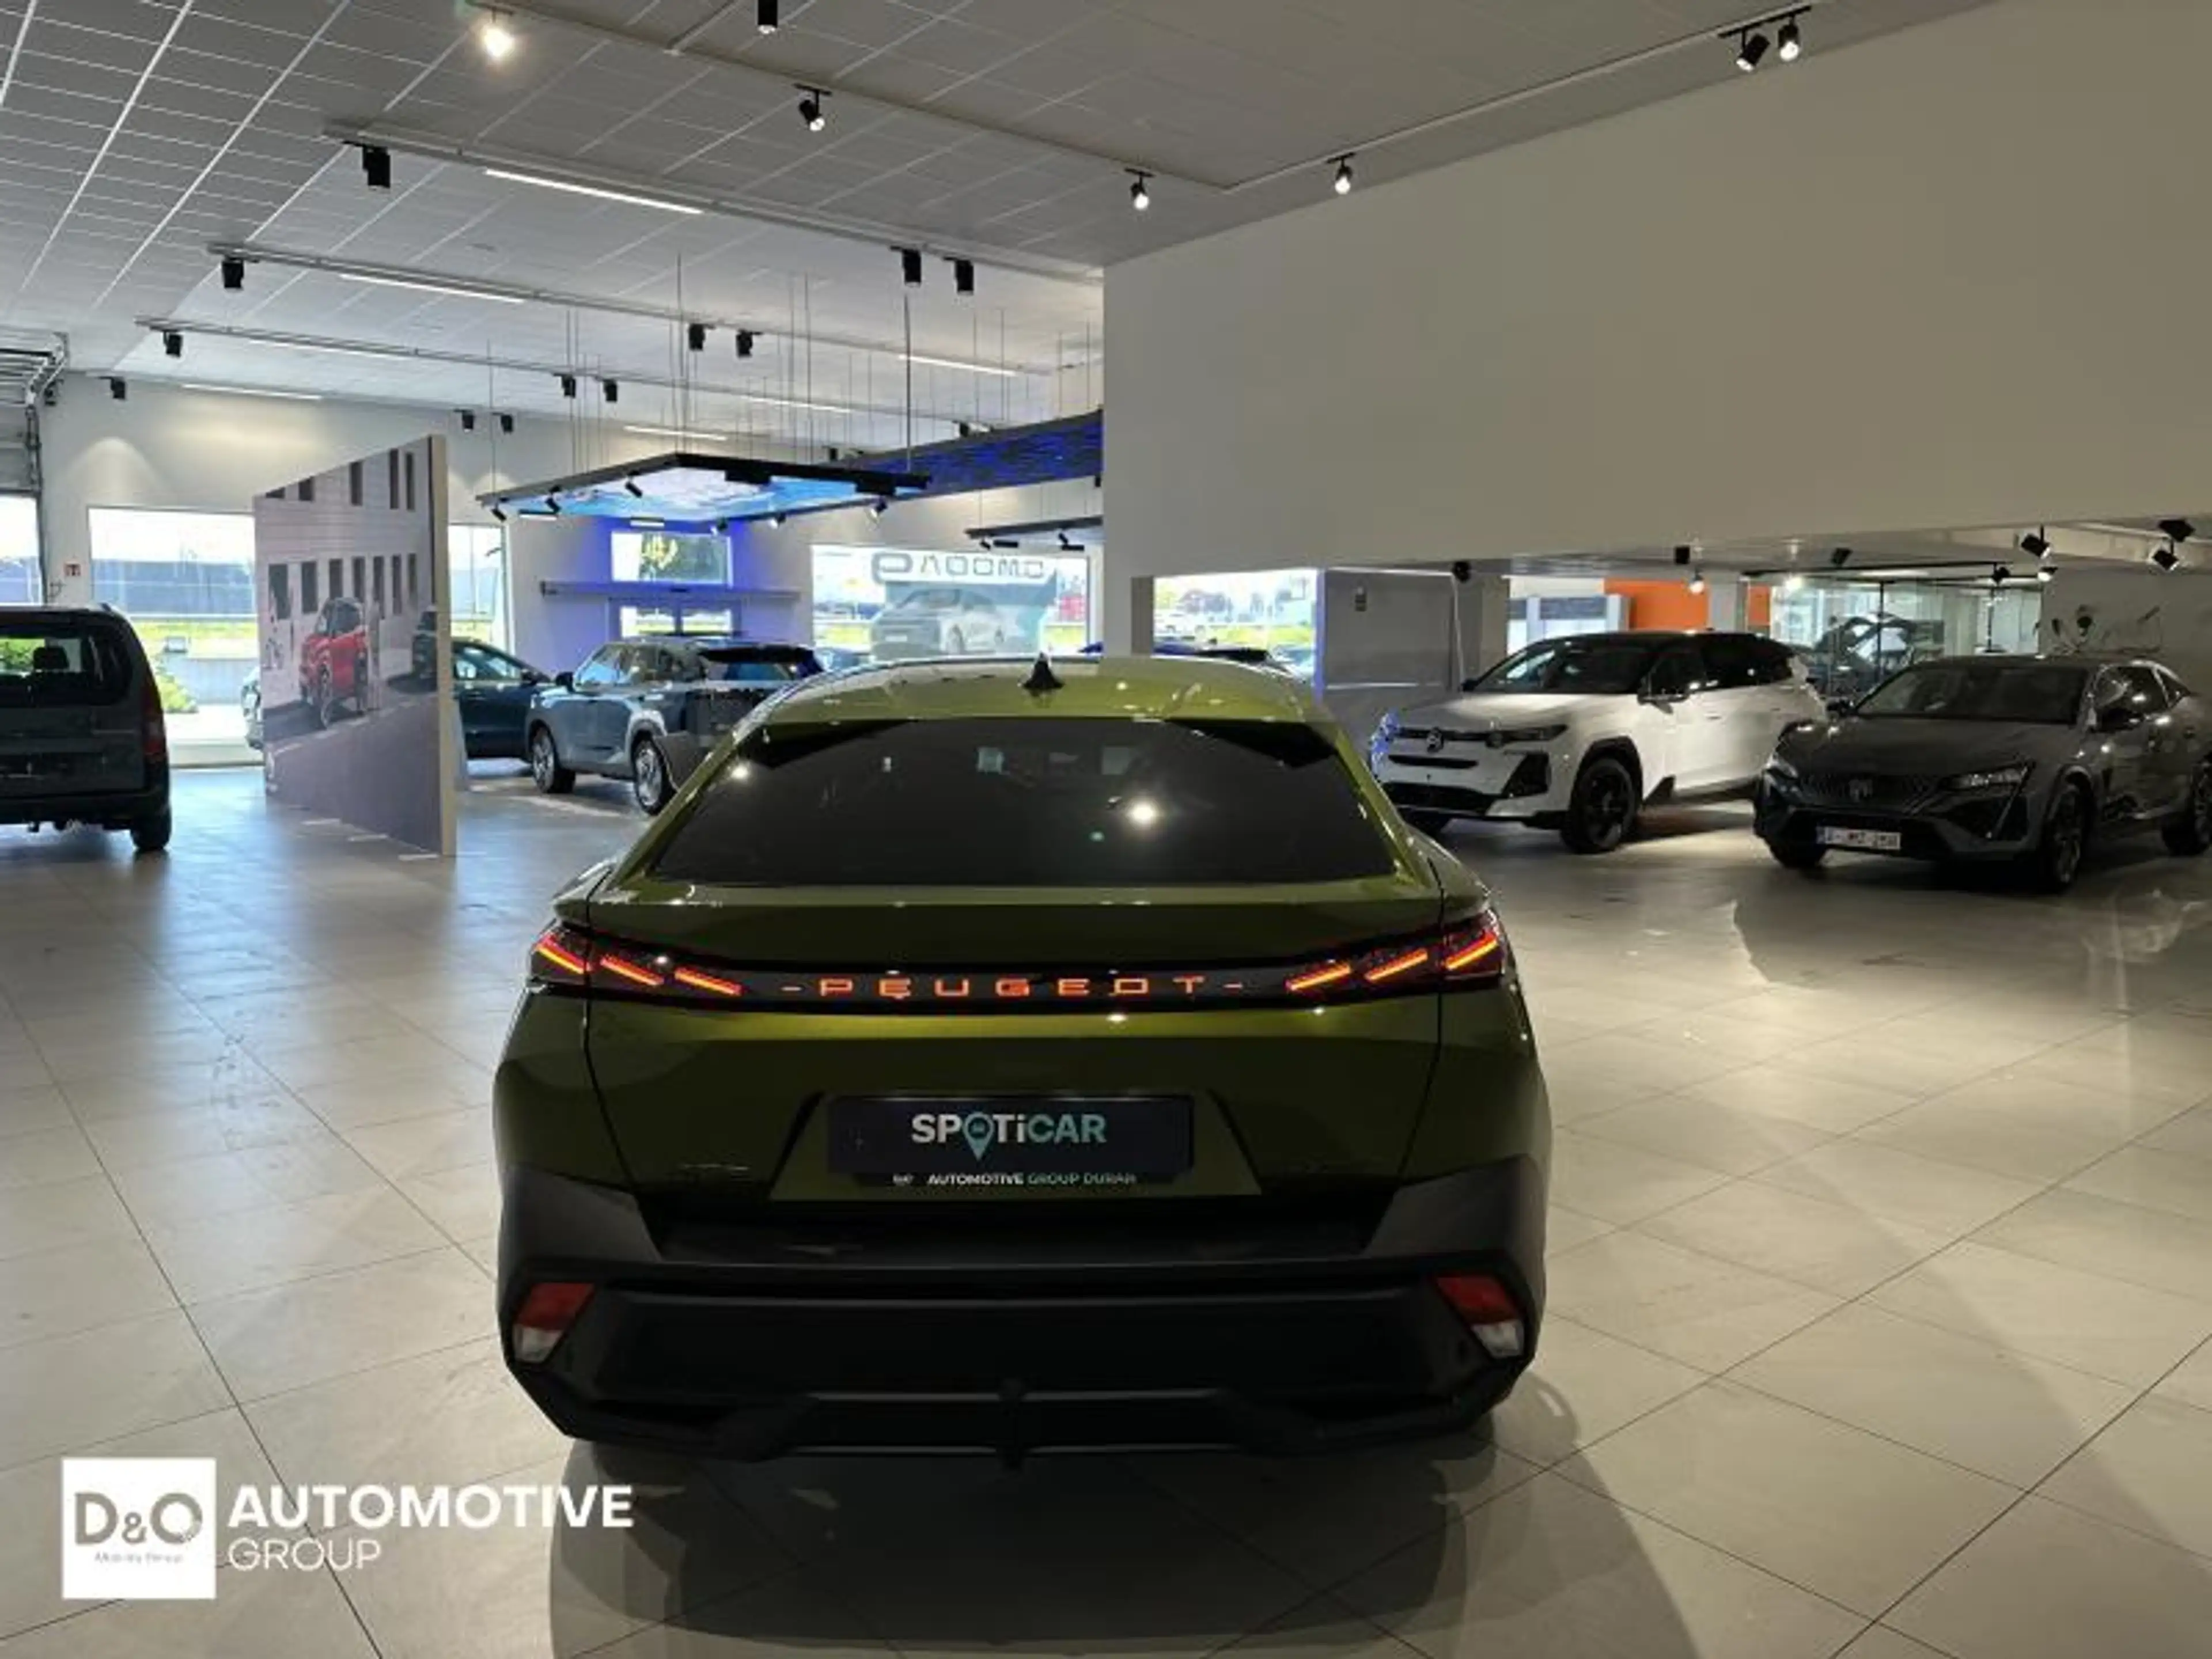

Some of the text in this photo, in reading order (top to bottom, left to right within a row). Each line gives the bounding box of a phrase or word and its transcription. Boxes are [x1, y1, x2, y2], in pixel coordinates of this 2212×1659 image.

[819, 976, 1206, 998] PEUGEOT
[927, 1172, 1024, 1185] AUTOMOTIVE
[1027, 1172, 1080, 1185] GROUP
